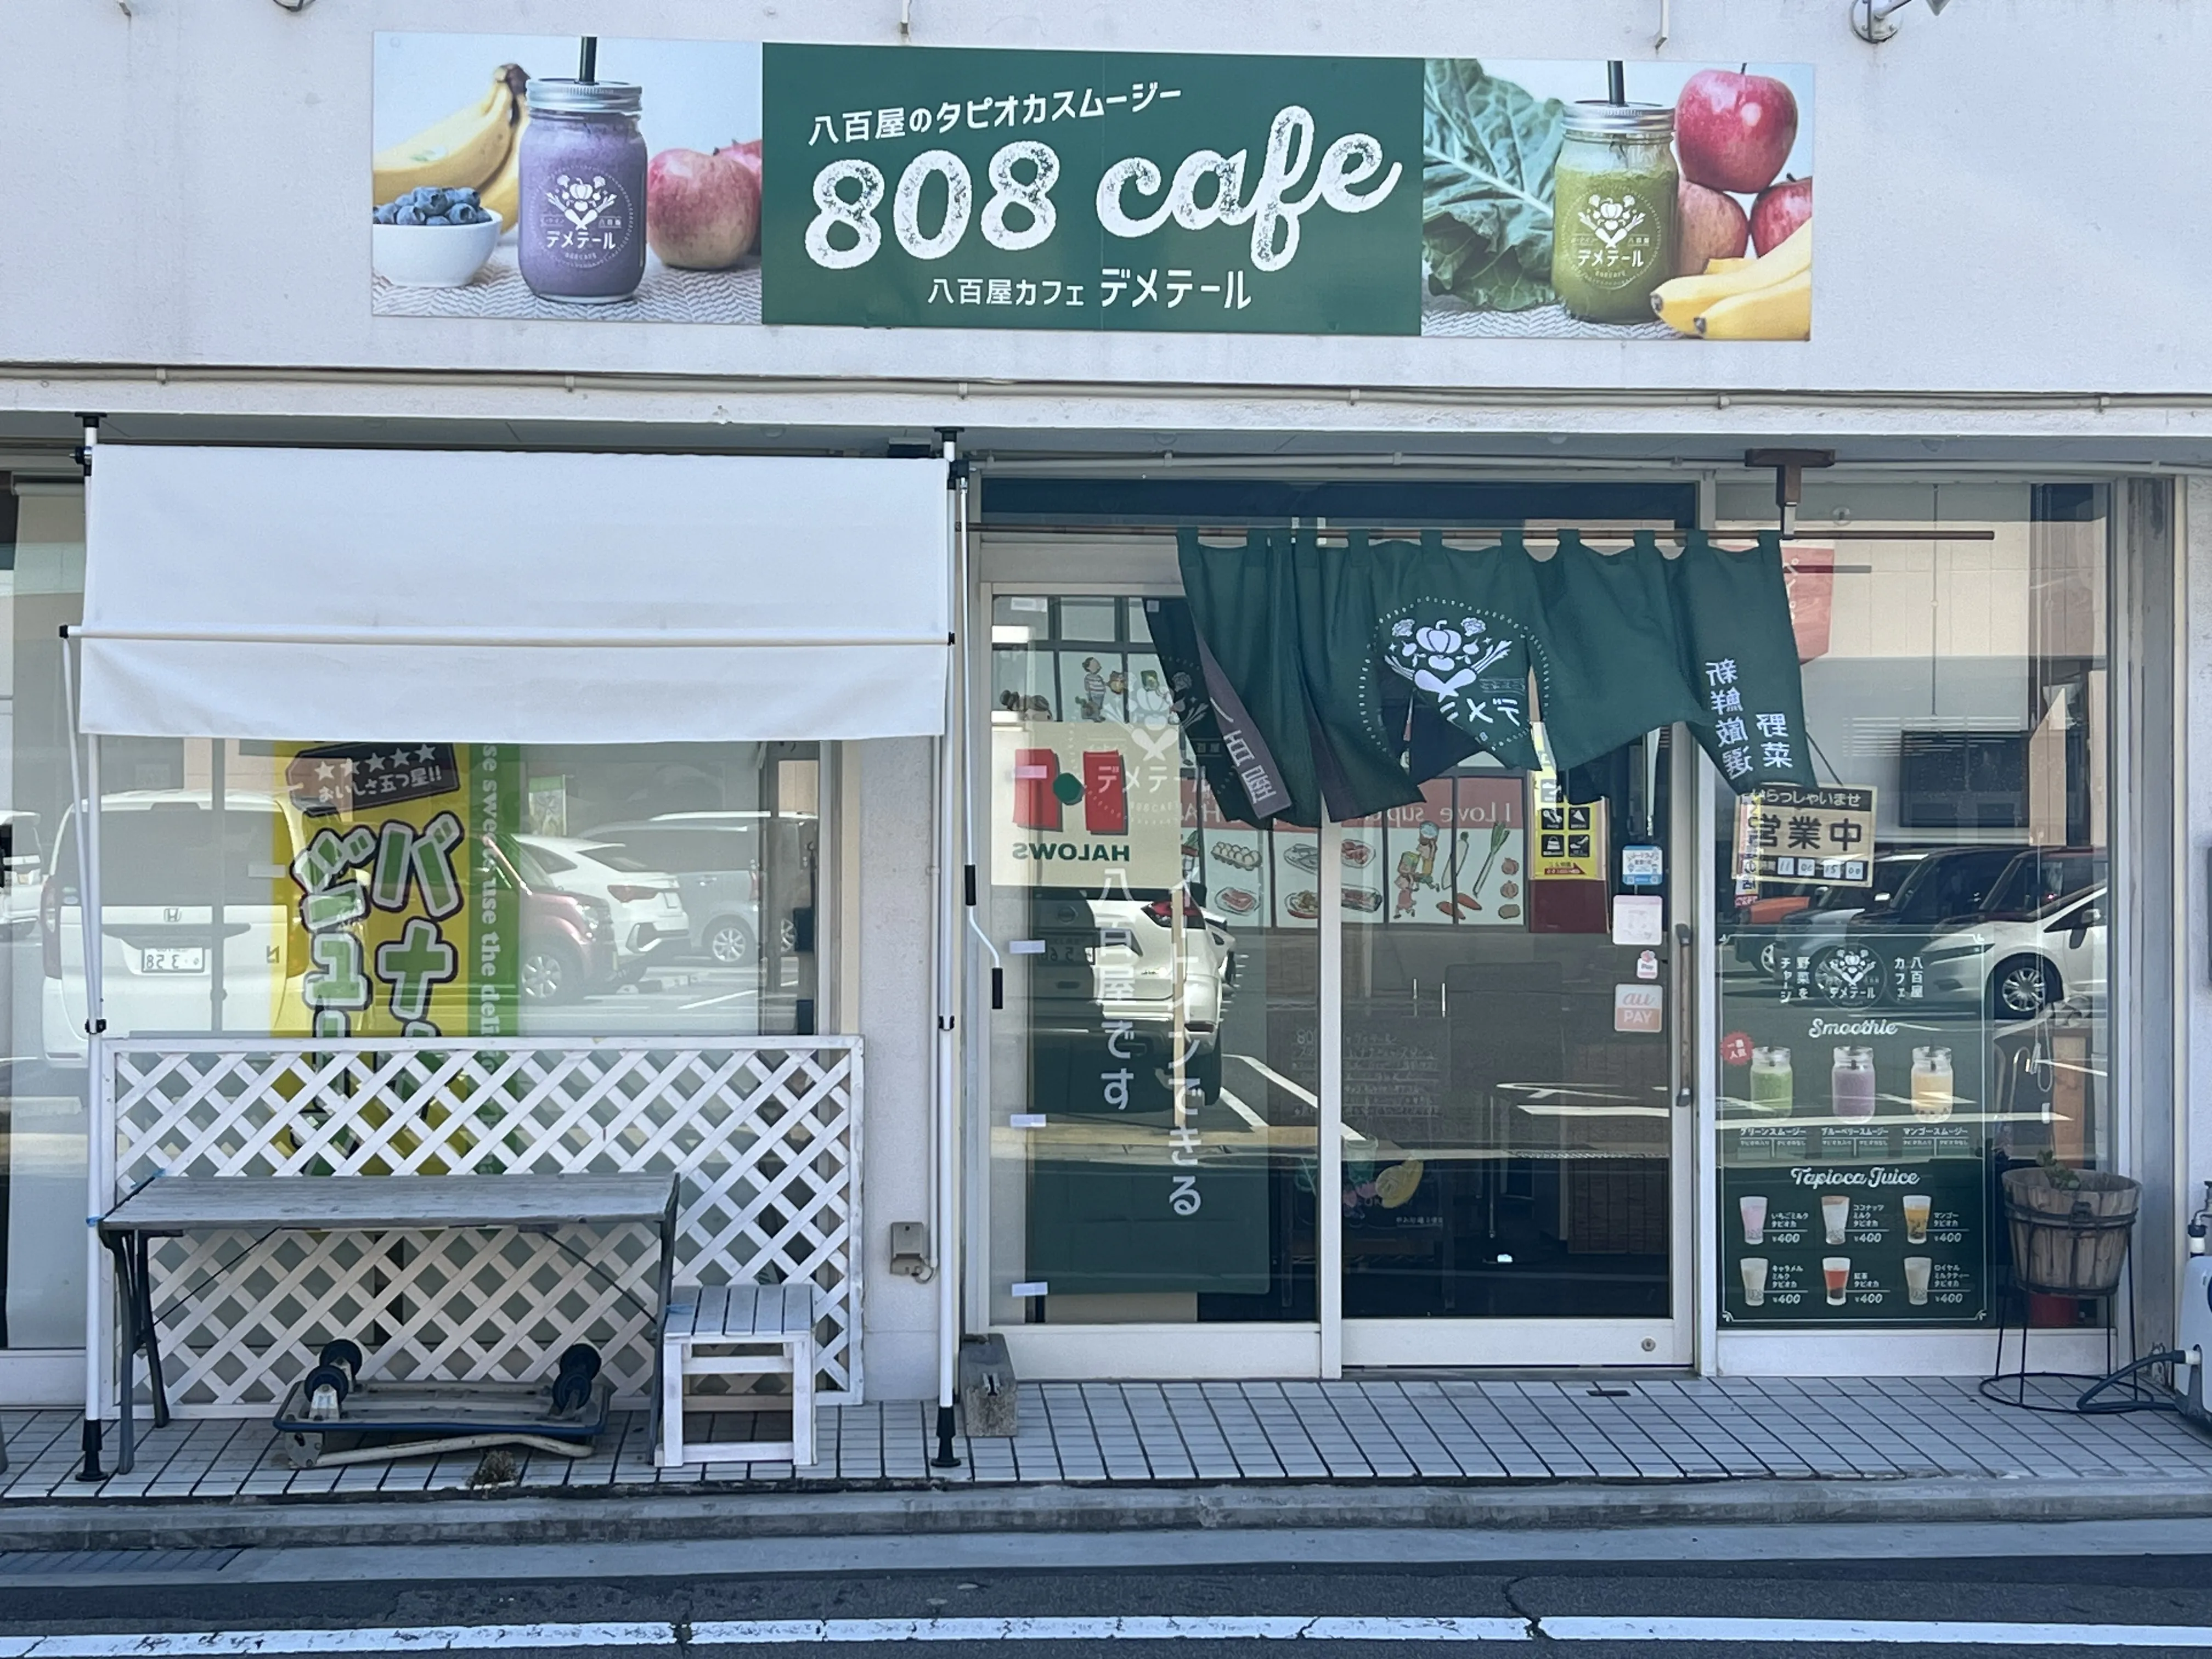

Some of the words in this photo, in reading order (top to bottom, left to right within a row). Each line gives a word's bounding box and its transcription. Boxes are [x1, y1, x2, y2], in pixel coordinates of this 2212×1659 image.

[808, 81, 1182, 146] 八百屋のタピオカスムージー
[804, 140, 1060, 269] 808
[1097, 105, 1403, 271] cafe
[928, 279, 1085, 307] 八百屋カフェ
[1101, 267, 1251, 309] デメテール
[1749, 814, 1861, 851] 営業中
[1623, 1009, 1653, 1024] PAY
[1809, 1018, 1899, 1038] Smoothie
[1791, 1167, 1867, 1189] Tapioca
[1867, 1167, 1921, 1188] Juice
